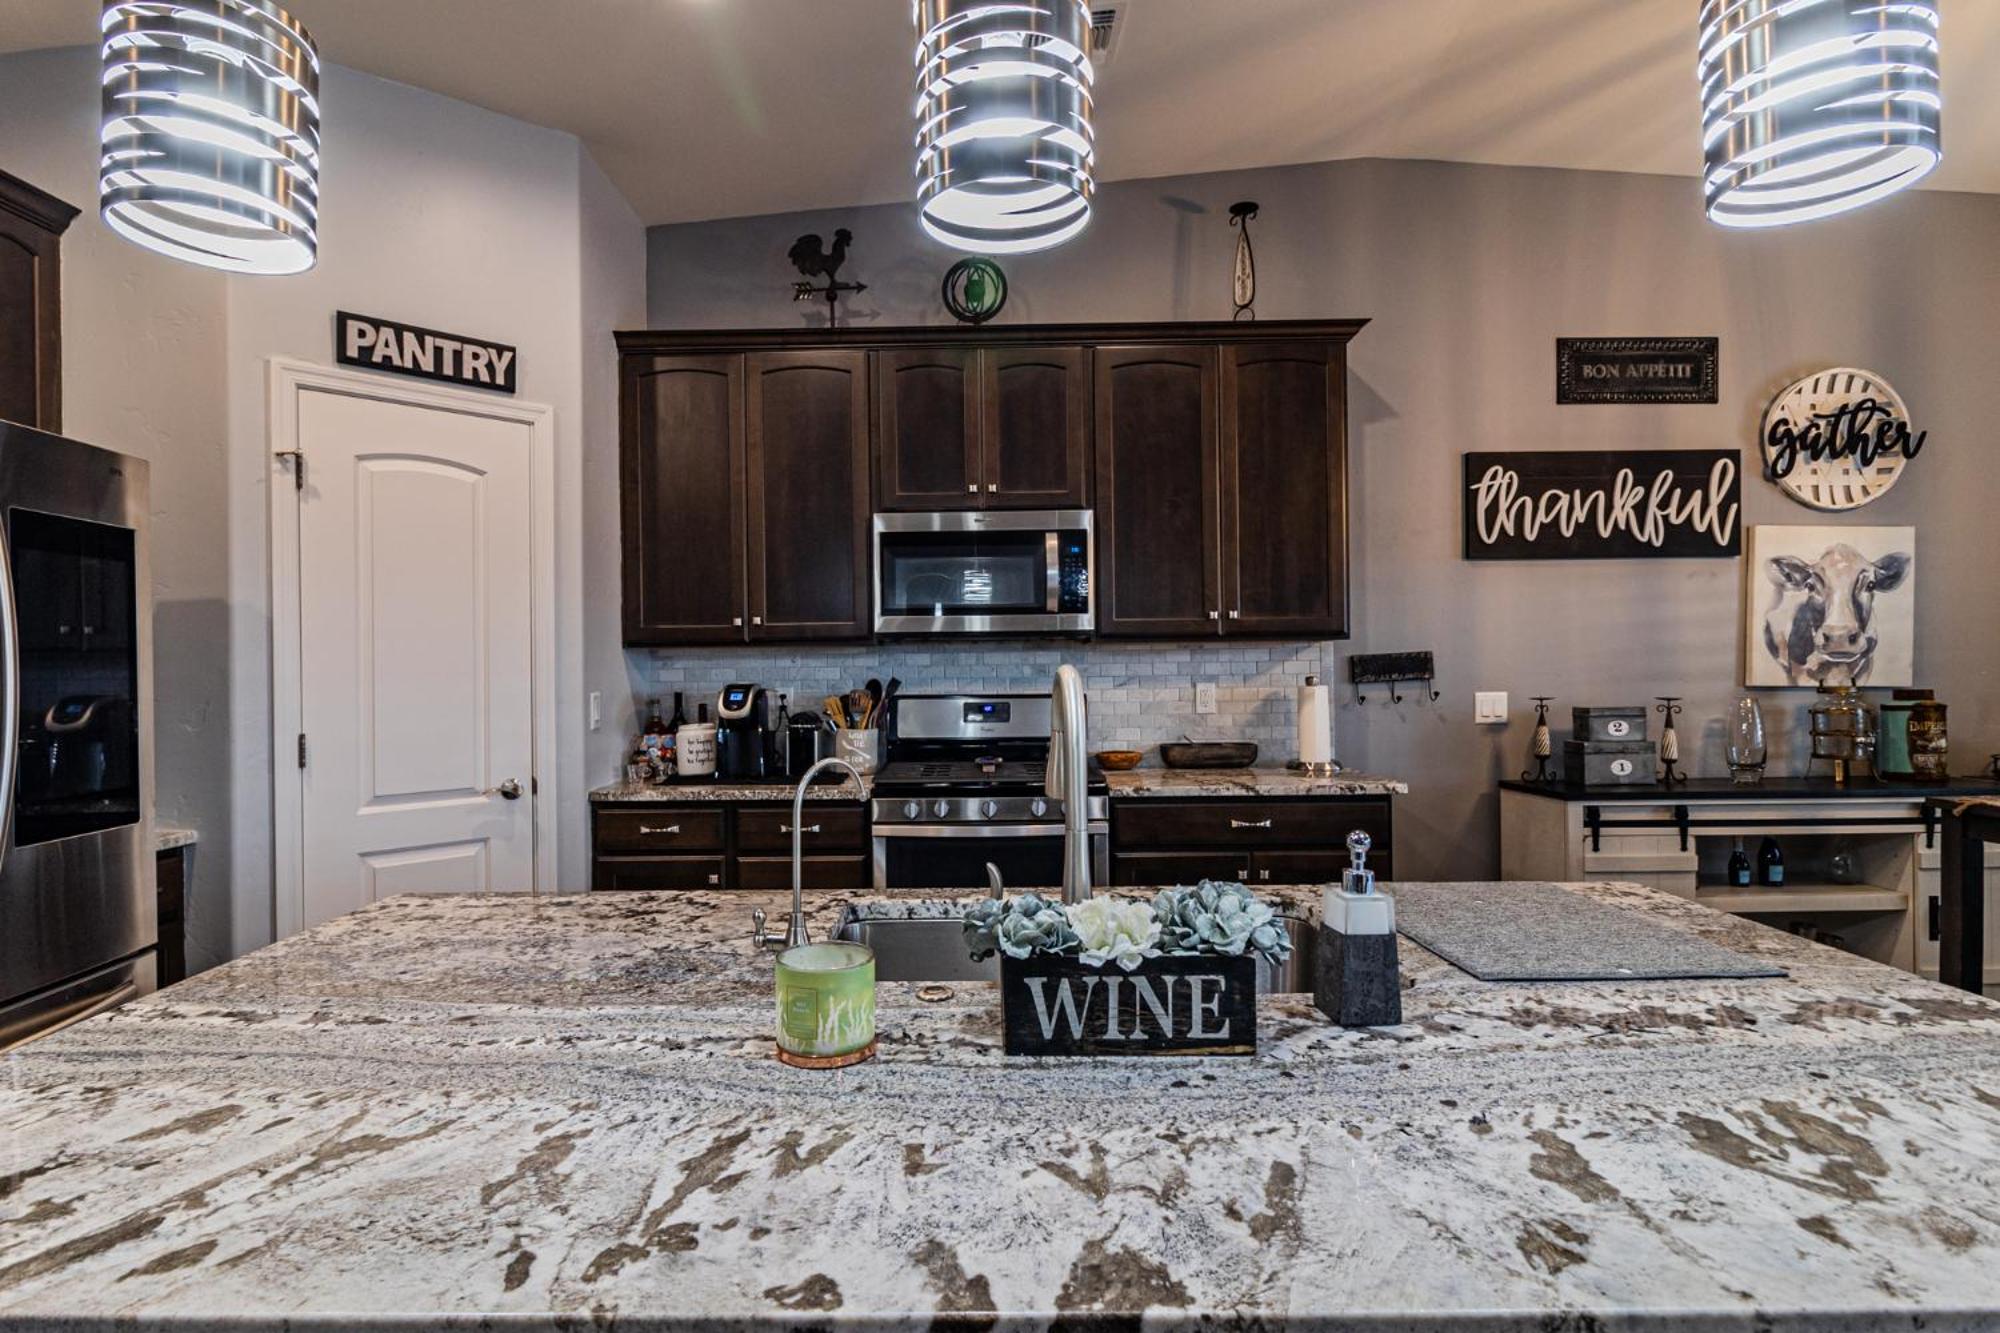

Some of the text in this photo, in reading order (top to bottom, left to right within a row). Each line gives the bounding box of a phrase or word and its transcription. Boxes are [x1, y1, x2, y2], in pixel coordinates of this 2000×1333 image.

[346, 319, 514, 386] PANTRY
[1582, 363, 1620, 379] BON
[1768, 398, 1927, 478] gather
[1470, 458, 1739, 547] thankful
[1613, 722, 1622, 732] 2
[1023, 975, 1231, 1040] WINE
